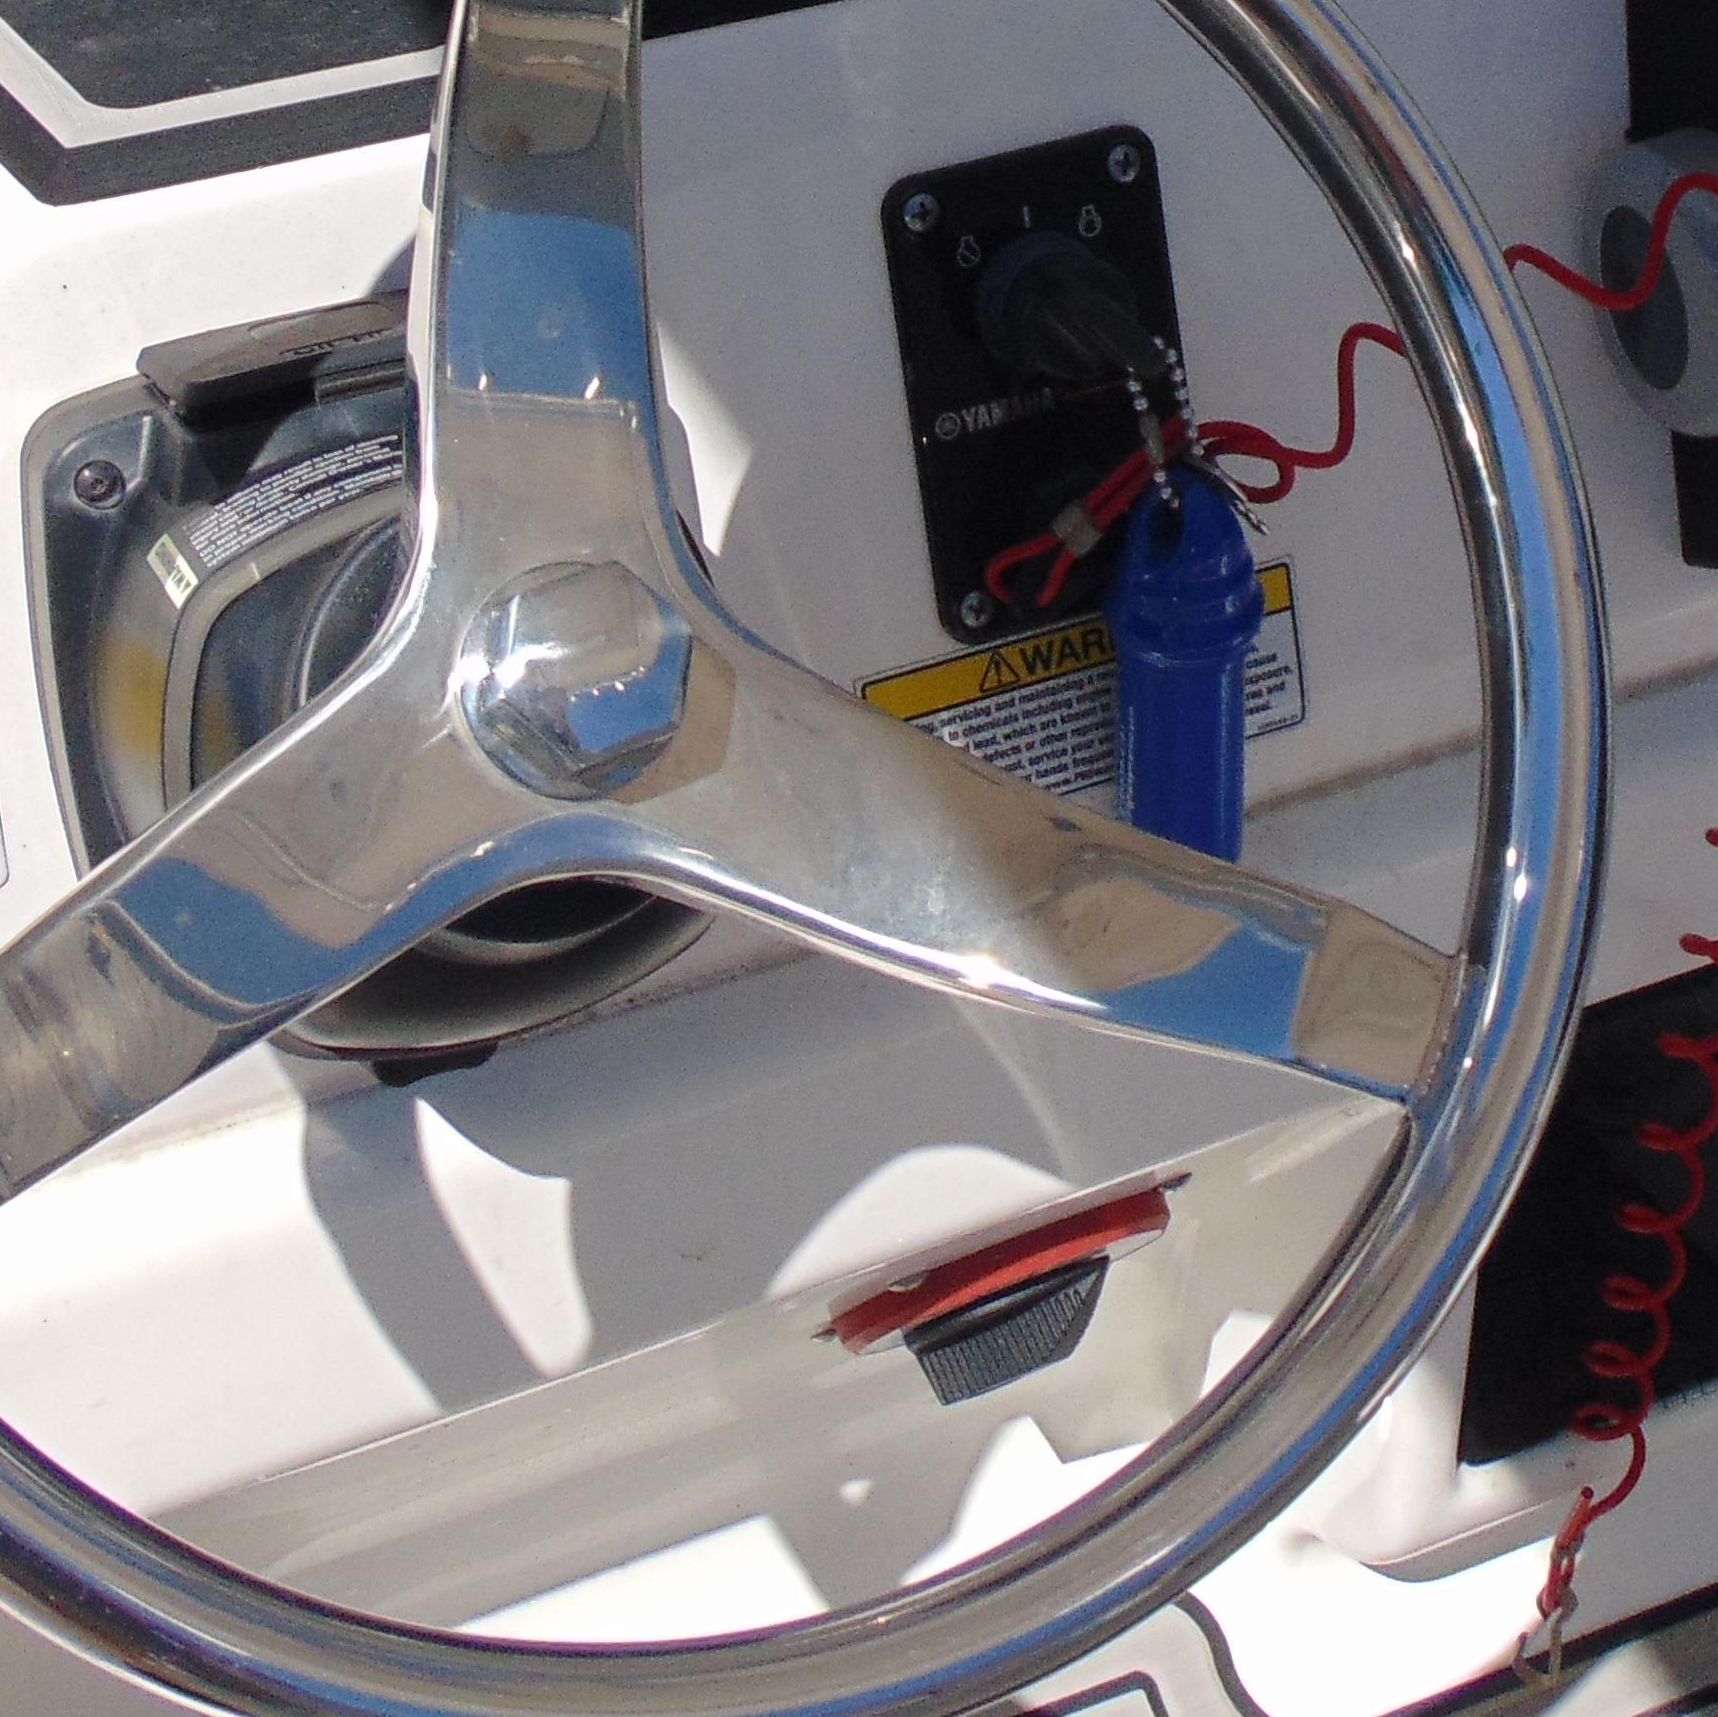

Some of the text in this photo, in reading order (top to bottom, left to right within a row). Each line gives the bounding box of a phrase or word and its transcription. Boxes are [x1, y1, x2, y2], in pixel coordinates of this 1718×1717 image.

[961, 387, 1055, 433] YAMAHA
[993, 695, 1015, 712] and
[948, 728, 958, 741] to
